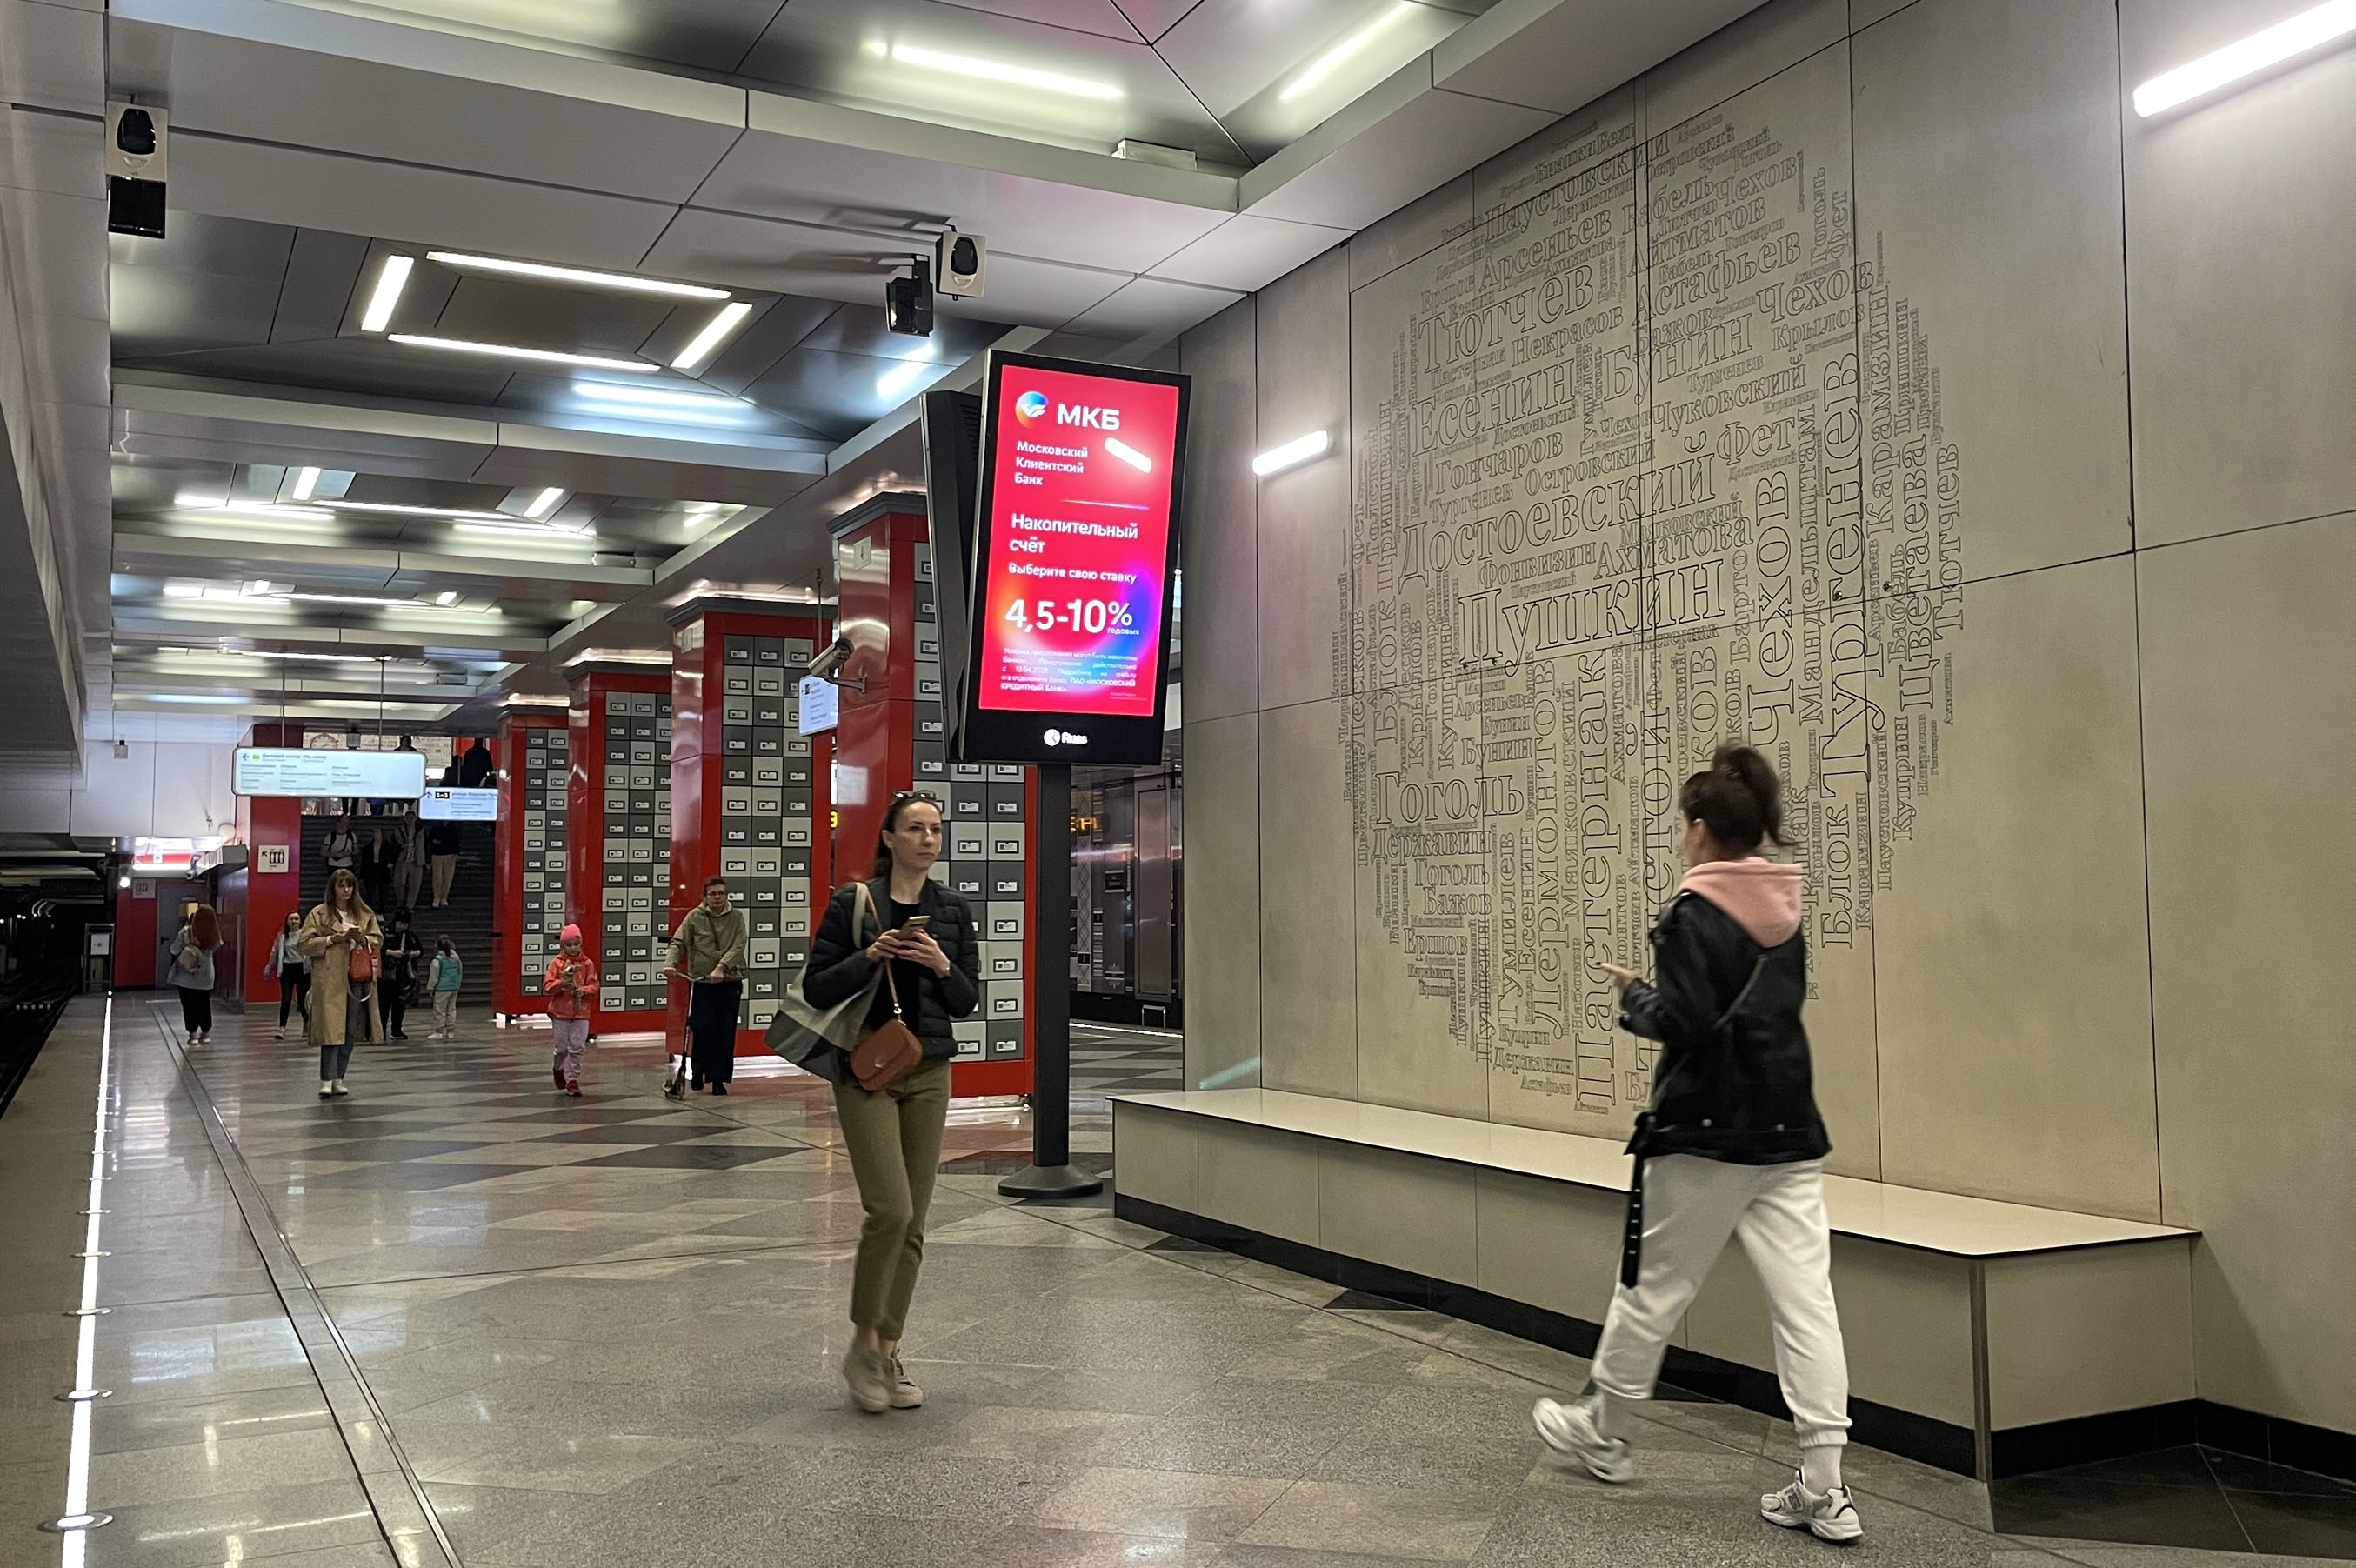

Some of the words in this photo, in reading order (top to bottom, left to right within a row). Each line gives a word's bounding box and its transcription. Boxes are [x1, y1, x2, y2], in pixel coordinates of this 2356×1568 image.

[1484, 130, 1669, 243] Паустовский
[1622, 175, 1714, 236] Бабель
[1714, 157, 1797, 207] Чехов
[1811, 167, 1826, 267] Гоголь
[1478, 210, 1612, 292] Арсеньев
[1543, 236, 1616, 280] Ахматова
[1628, 197, 1766, 277] Айтматов
[1827, 190, 1850, 260] Фет
[1632, 231, 1801, 326] Астафьев
[1659, 250, 1713, 285] Бабель
[1756, 261, 1873, 324] Чехов
[1418, 264, 1594, 374] Тютчев
[1512, 306, 1623, 367] Некрасов
[1603, 313, 1752, 405] Бунин
[1633, 307, 1713, 353] Бажов
[1772, 304, 1865, 351] Крылов
[1412, 358, 1575, 457] Есенин
[1580, 343, 1597, 457] Гумилев
[1652, 353, 1806, 437] Чуковский
[1687, 355, 1764, 395] Тургенев
[1865, 285, 1900, 538] Карамзин
[1016, 440, 1089, 459] Московский
[1057, 403, 1120, 430] МКБ
[1492, 399, 1580, 449] Достоевский
[1600, 409, 1654, 439] Чехов
[1716, 416, 1796, 467] Фет
[1014, 472, 1044, 487] Банк
[1015, 457, 1084, 474] Клиентский
[1377, 399, 1398, 593] Пришвин
[1428, 482, 1514, 526] Тургенев
[1435, 432, 1564, 494] Гончаров
[1525, 431, 1657, 497] Островский
[1009, 537, 1046, 554] счёт
[1011, 513, 1138, 540] Накопительный
[1398, 431, 1716, 595] Достоевский
[1593, 516, 1754, 580] Ахматова
[1619, 492, 1744, 548] Маяковский
[1933, 444, 1963, 641] Тютчев
[1008, 563, 1066, 580] Выберите
[1068, 568, 1098, 581] свою
[1099, 570, 1138, 585] ставку
[1478, 541, 1597, 590] Фонвизин
[1797, 404, 1826, 725] Мандельштам
[1818, 352, 1885, 799] Тургенев
[1885, 544, 1907, 663] Бабель
[1899, 434, 1940, 712] Цветаева
[1458, 558, 1725, 677] Пушкин
[1729, 549, 1755, 666] Барто
[1747, 471, 1794, 747] Чехов
[1350, 609, 1365, 757] Лесков
[1372, 596, 1398, 746] Блок
[1398, 602, 1412, 713] Лесков
[1408, 620, 1427, 767] Крылов
[1425, 588, 1438, 721] Гончаров
[1438, 624, 1458, 771] Куприн
[1454, 693, 1530, 721] Арсеньев
[1482, 715, 1531, 739] Бунин
[1608, 642, 1625, 785] Ахматова
[1460, 737, 1533, 772] Бунин
[1892, 716, 1916, 842] Куприн
[1375, 771, 1525, 824] Гоголь
[1555, 680, 1579, 922] Маяковский
[1871, 729, 1894, 891] Паустовский
[1371, 827, 1492, 867] Державин
[1414, 857, 1490, 887] Гоголь
[1531, 660, 1569, 1041] Лермонтов
[1575, 649, 1622, 1107] Пастернак
[1810, 800, 1826, 889] Крылов
[1819, 804, 1852, 950] Блок
[1854, 791, 1871, 931] Карамзин
[1423, 886, 1492, 916] Бажов
[1498, 831, 1522, 1024] Гумилев
[1517, 828, 1537, 974] Есенин
[1631, 891, 1642, 971] ютчев
[1404, 927, 1468, 961] Ершов
[1457, 957, 1469, 1048] Пушкин
[1476, 919, 1496, 1063] Пушкин
[1493, 1046, 1574, 1075] Державин
[1498, 1023, 1550, 1050] Куприн
